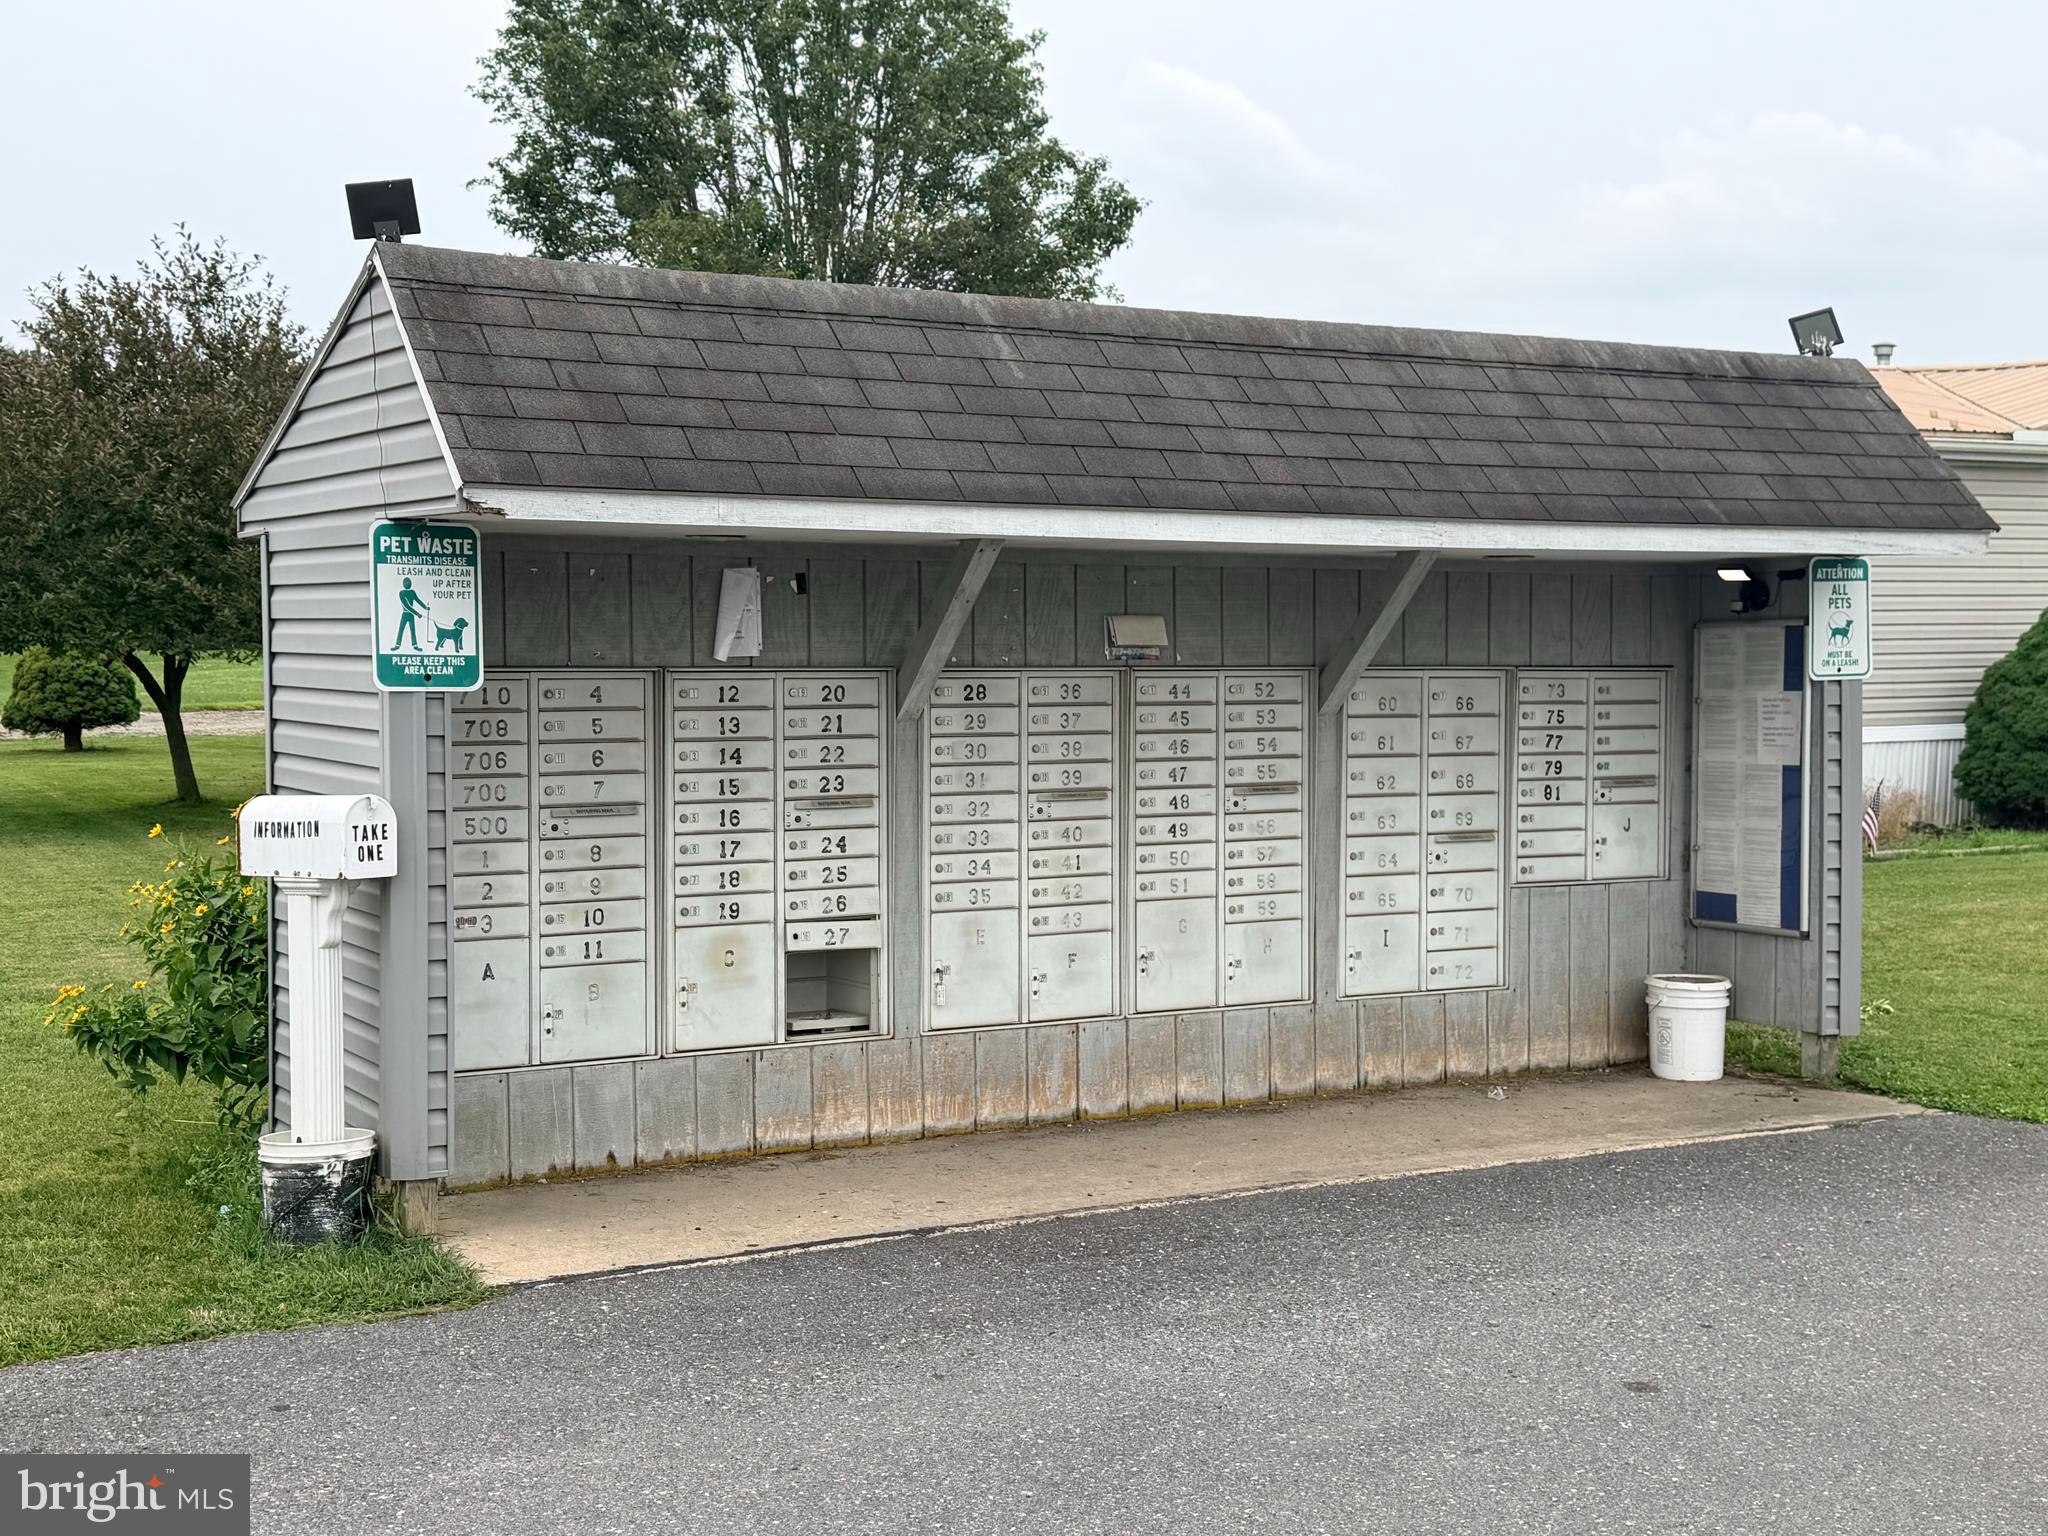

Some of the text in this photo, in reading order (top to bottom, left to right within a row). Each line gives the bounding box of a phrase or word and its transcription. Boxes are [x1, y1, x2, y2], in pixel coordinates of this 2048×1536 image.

[380, 536, 473, 555] PET WASTE
[386, 555, 467, 565] TRANSMITS DISEASE
[397, 567, 471, 577] LEASH AND CLEAN
[1817, 568, 1863, 579] ATTENTION
[433, 580, 471, 588] UP AFTER
[1832, 584, 1848, 595] ALL
[433, 591, 471, 599] YOUR PET
[1829, 598, 1851, 608] PETS
[392, 657, 465, 665] PLEASE KEEP THIS
[404, 666, 424, 674] AREA
[589, 686, 602, 703] 4
[719, 685, 739, 703] 12
[821, 685, 845, 702] 20
[963, 684, 987, 701] 28
[1060, 684, 1081, 700] 36
[1169, 683, 1190, 699] 44
[1255, 682, 1274, 698] 52
[1378, 697, 1397, 711] 60
[1456, 697, 1474, 711] 66
[821, 714, 843, 733] 21
[964, 714, 986, 730] 29
[1060, 712, 1081, 728] 37
[1169, 711, 1189, 726] 45
[1257, 709, 1276, 725] 53
[1547, 709, 1565, 724] 75
[464, 719, 508, 737] 708
[591, 718, 603, 735] 5
[719, 717, 740, 735] 13
[1061, 741, 1082, 757] 38
[1168, 739, 1189, 755] 46
[1257, 737, 1277, 752] 54
[1378, 736, 1394, 751] 61
[1456, 736, 1474, 750] 67
[1545, 734, 1563, 749] 77
[592, 750, 604, 767] 6
[719, 748, 742, 765] 14
[820, 746, 845, 763] 22
[964, 743, 987, 759] 30
[464, 752, 507, 770] 706
[1545, 760, 1562, 775] 79
[965, 772, 985, 788] 31
[1061, 770, 1082, 786] 39
[1168, 767, 1187, 782] 47
[1257, 764, 1277, 780] 55
[719, 778, 740, 796] 15
[820, 775, 845, 793] 23
[1377, 776, 1396, 790] 62
[1456, 774, 1474, 788] 68
[464, 784, 507, 803] 700
[593, 781, 605, 798] 7
[1544, 785, 1560, 801] 81
[968, 801, 990, 817] 32
[1169, 794, 1190, 810] 48
[465, 817, 507, 835] 500
[720, 809, 740, 827] 16
[1378, 814, 1396, 829] 63
[1456, 812, 1473, 826] 69
[1623, 818, 1631, 832] J
[254, 820, 319, 838] INFORMATION
[352, 824, 388, 842] TAKE
[1061, 826, 1082, 842] 40
[1168, 822, 1188, 838] 49
[821, 836, 847, 854] 24
[967, 830, 990, 846] 33
[358, 844, 383, 862] ONE
[590, 845, 602, 862] 8
[720, 840, 741, 858] 17
[481, 851, 489, 868] 1
[1170, 850, 1190, 866] 50
[1378, 853, 1398, 868] 64
[822, 865, 847, 884] 25
[968, 859, 991, 876] 34
[590, 877, 601, 895] 9
[719, 870, 740, 889] 18
[1170, 878, 1188, 894] 51
[482, 882, 493, 900] 2
[968, 888, 991, 905] 35
[1061, 884, 1083, 900] 42
[1456, 888, 1473, 902] 70
[822, 895, 847, 914] 26
[1378, 893, 1397, 907] 65
[584, 908, 604, 927] 10
[719, 902, 740, 920] 19
[481, 915, 493, 933] 3
[824, 928, 849, 945] 27
[1384, 929, 1389, 947] I
[584, 940, 603, 959] 11
[724, 950, 734, 967] C
[482, 963, 495, 981] A
